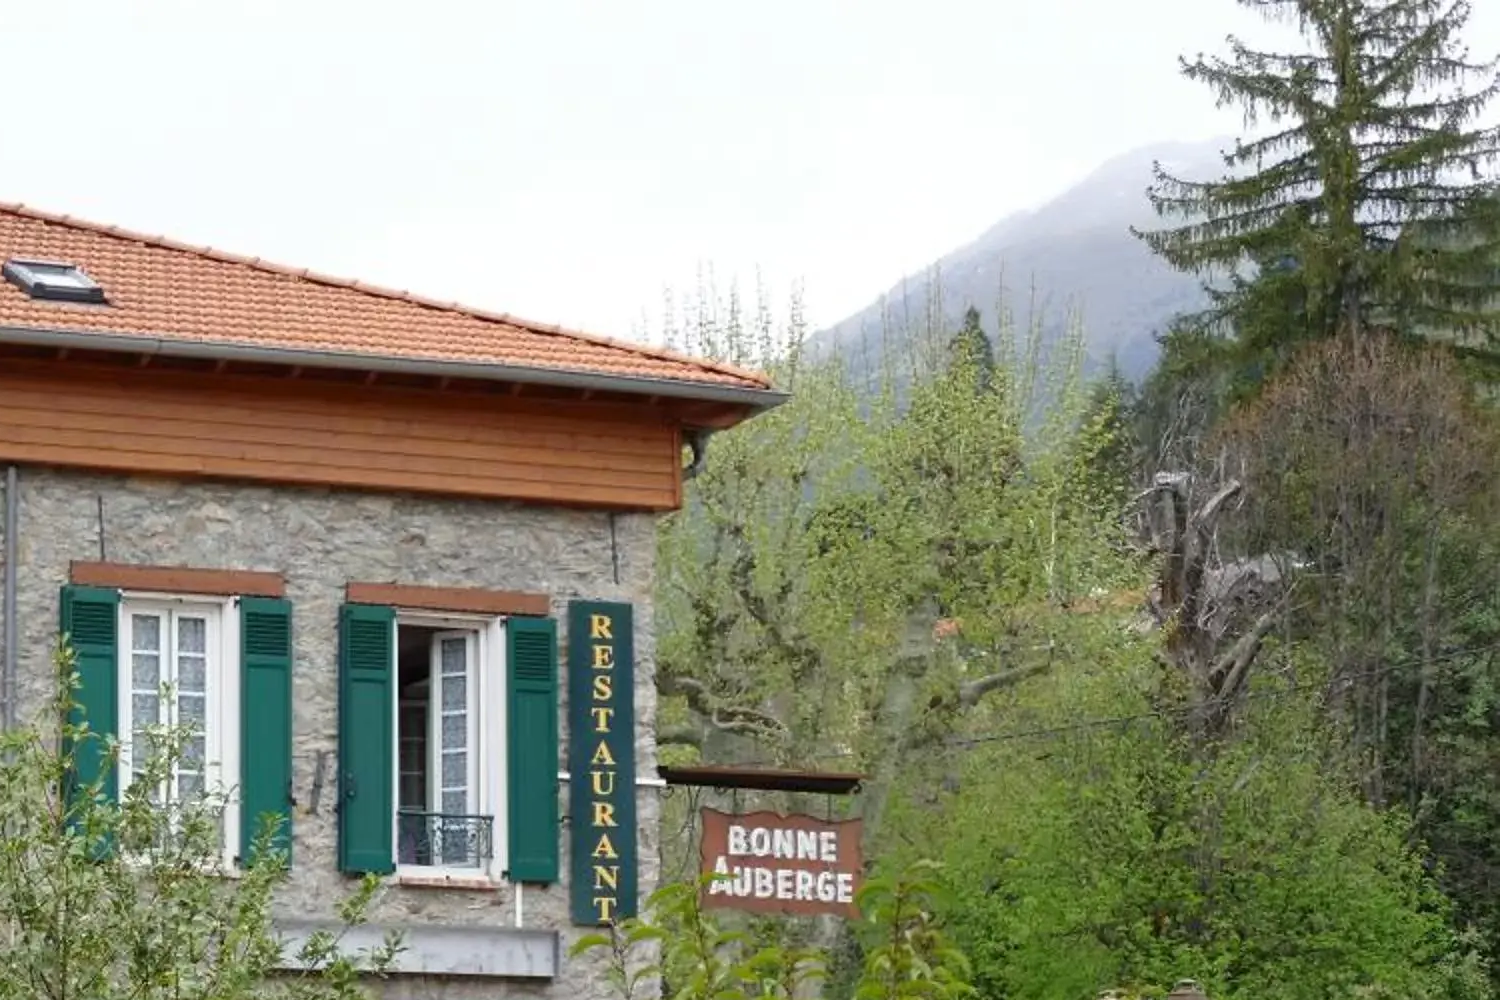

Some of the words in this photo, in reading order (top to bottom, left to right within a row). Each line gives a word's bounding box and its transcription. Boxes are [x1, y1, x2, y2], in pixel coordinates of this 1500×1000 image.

[589, 613, 619, 922] RESTAURANT
[728, 825, 838, 863] BONNE
[708, 855, 853, 903] AUBERGE
